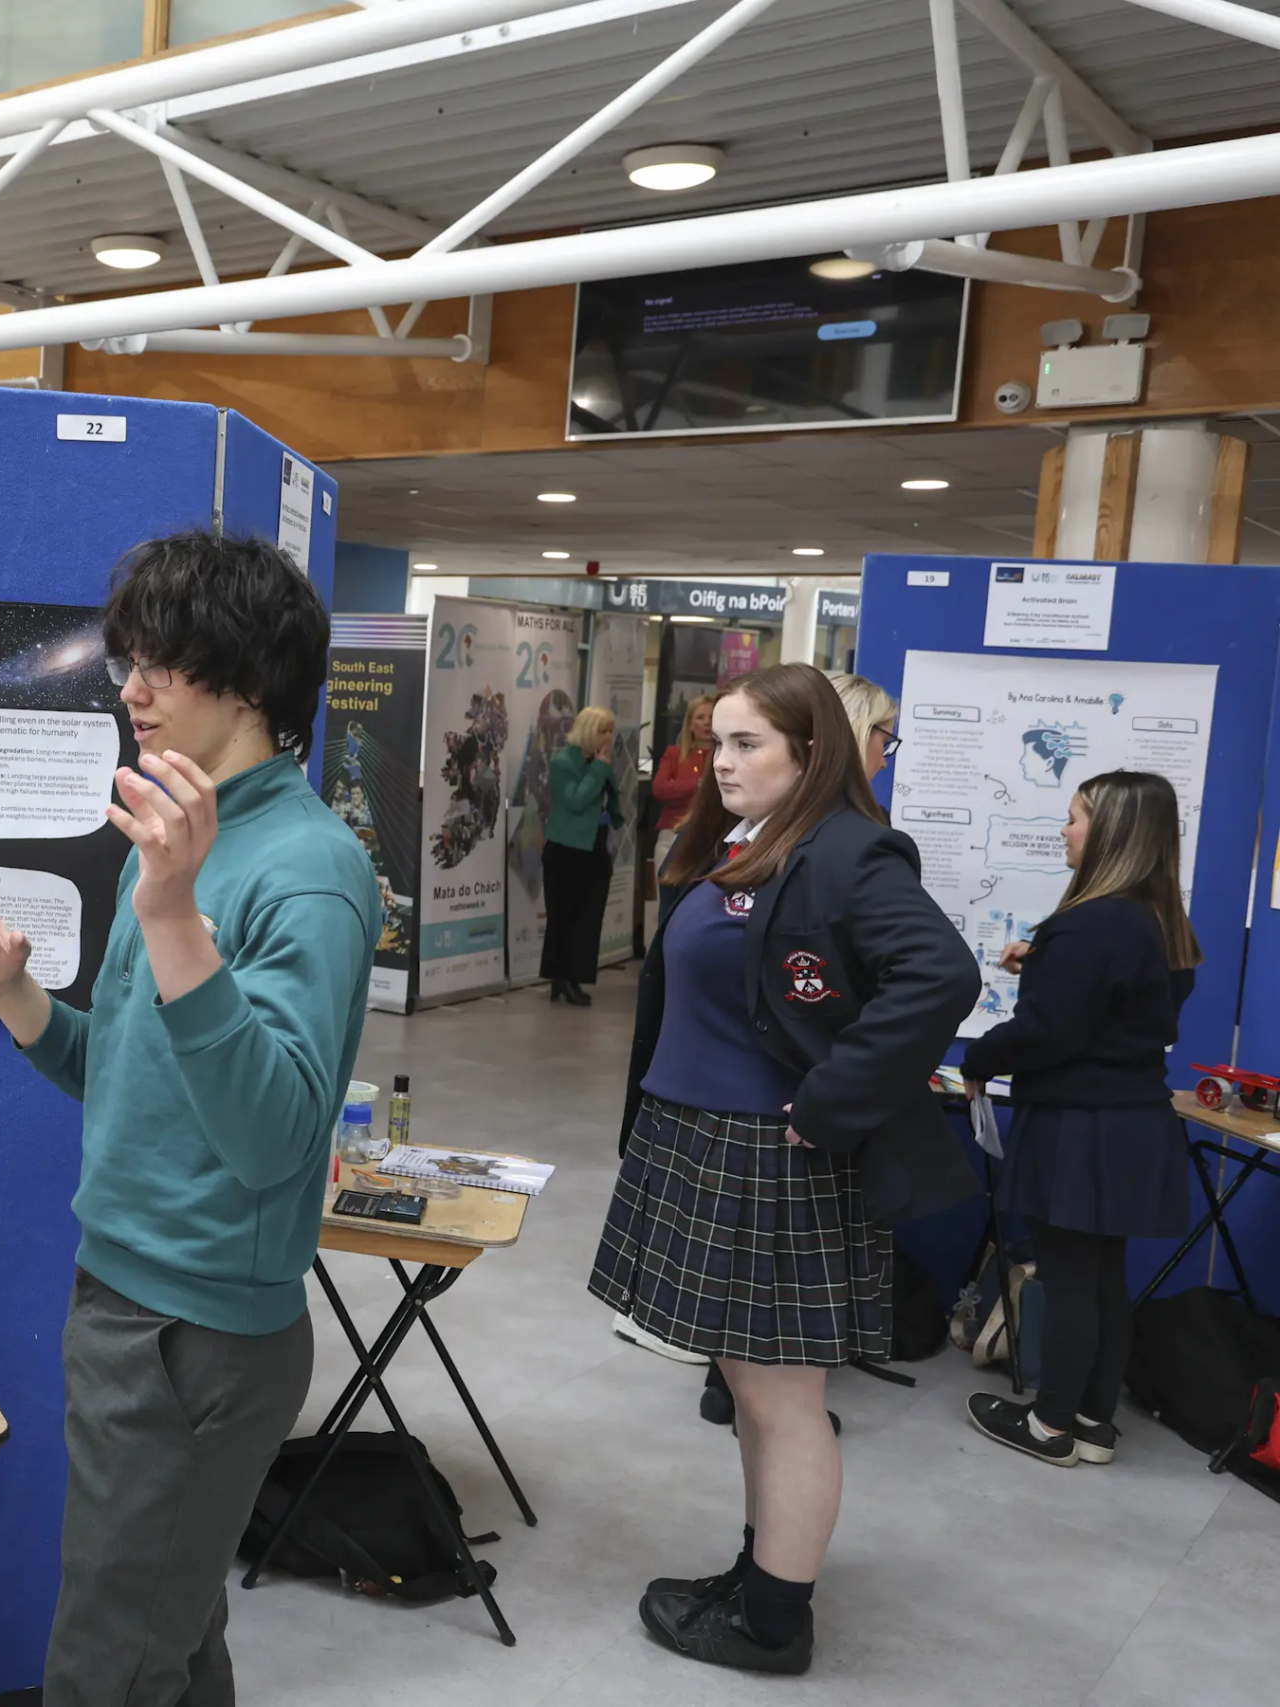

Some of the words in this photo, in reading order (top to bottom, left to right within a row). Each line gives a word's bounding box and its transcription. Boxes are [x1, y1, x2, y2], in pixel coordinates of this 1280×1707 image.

[86, 422, 103, 435] 22
[925, 575, 935, 583] 19
[629, 584, 648, 596] SE
[630, 595, 647, 607] TU
[689, 589, 726, 612] Oifig
[728, 597, 747, 609] na
[517, 616, 544, 630] MATHS
[545, 618, 561, 631] FOR
[562, 620, 575, 633] ALL
[332, 661, 365, 673] South
[369, 662, 394, 674] East
[327, 679, 393, 696] gineering
[1008, 692, 1016, 703] By
[1019, 694, 1033, 702] Ana
[1035, 694, 1063, 703] Carolina
[933, 707, 961, 718] Summary
[38, 717, 45, 725] in
[47, 718, 60, 726] the
[62, 718, 81, 727] solar
[83, 720, 111, 728] system
[1158, 721, 1172, 729] Data
[29, 727, 39, 735] for
[42, 728, 78, 739] humanity
[921, 809, 953, 818] Hypothesis
[434, 886, 455, 899] Mata
[459, 884, 470, 897] do
[474, 880, 501, 895] Chách
